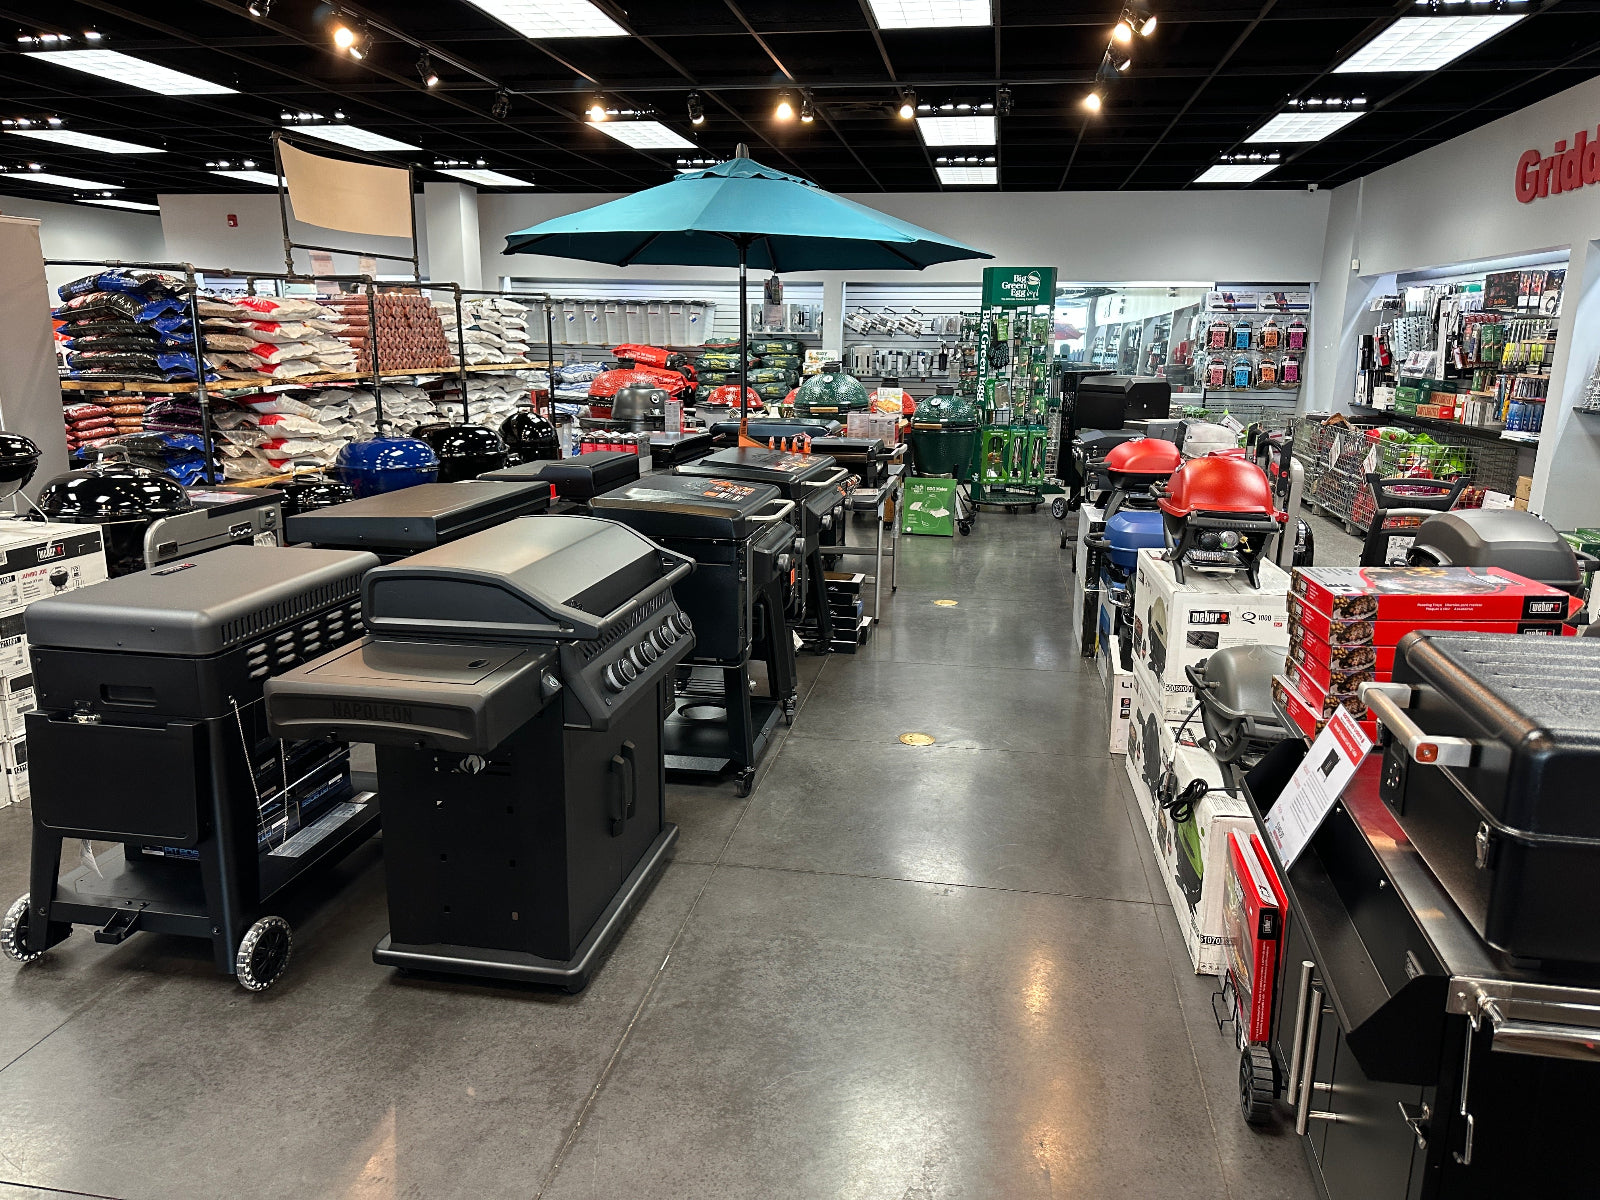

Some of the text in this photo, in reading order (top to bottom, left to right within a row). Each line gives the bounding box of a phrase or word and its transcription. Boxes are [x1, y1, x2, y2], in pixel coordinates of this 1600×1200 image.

[1013, 274, 1027, 284] Big
[1001, 281, 1027, 290] Green
[1010, 288, 1026, 298] Egg
[976, 309, 991, 402] Big Green Egg
[1532, 602, 1554, 612] weber
[1192, 611, 1220, 623] weber
[333, 702, 412, 722] NAPOLEON
